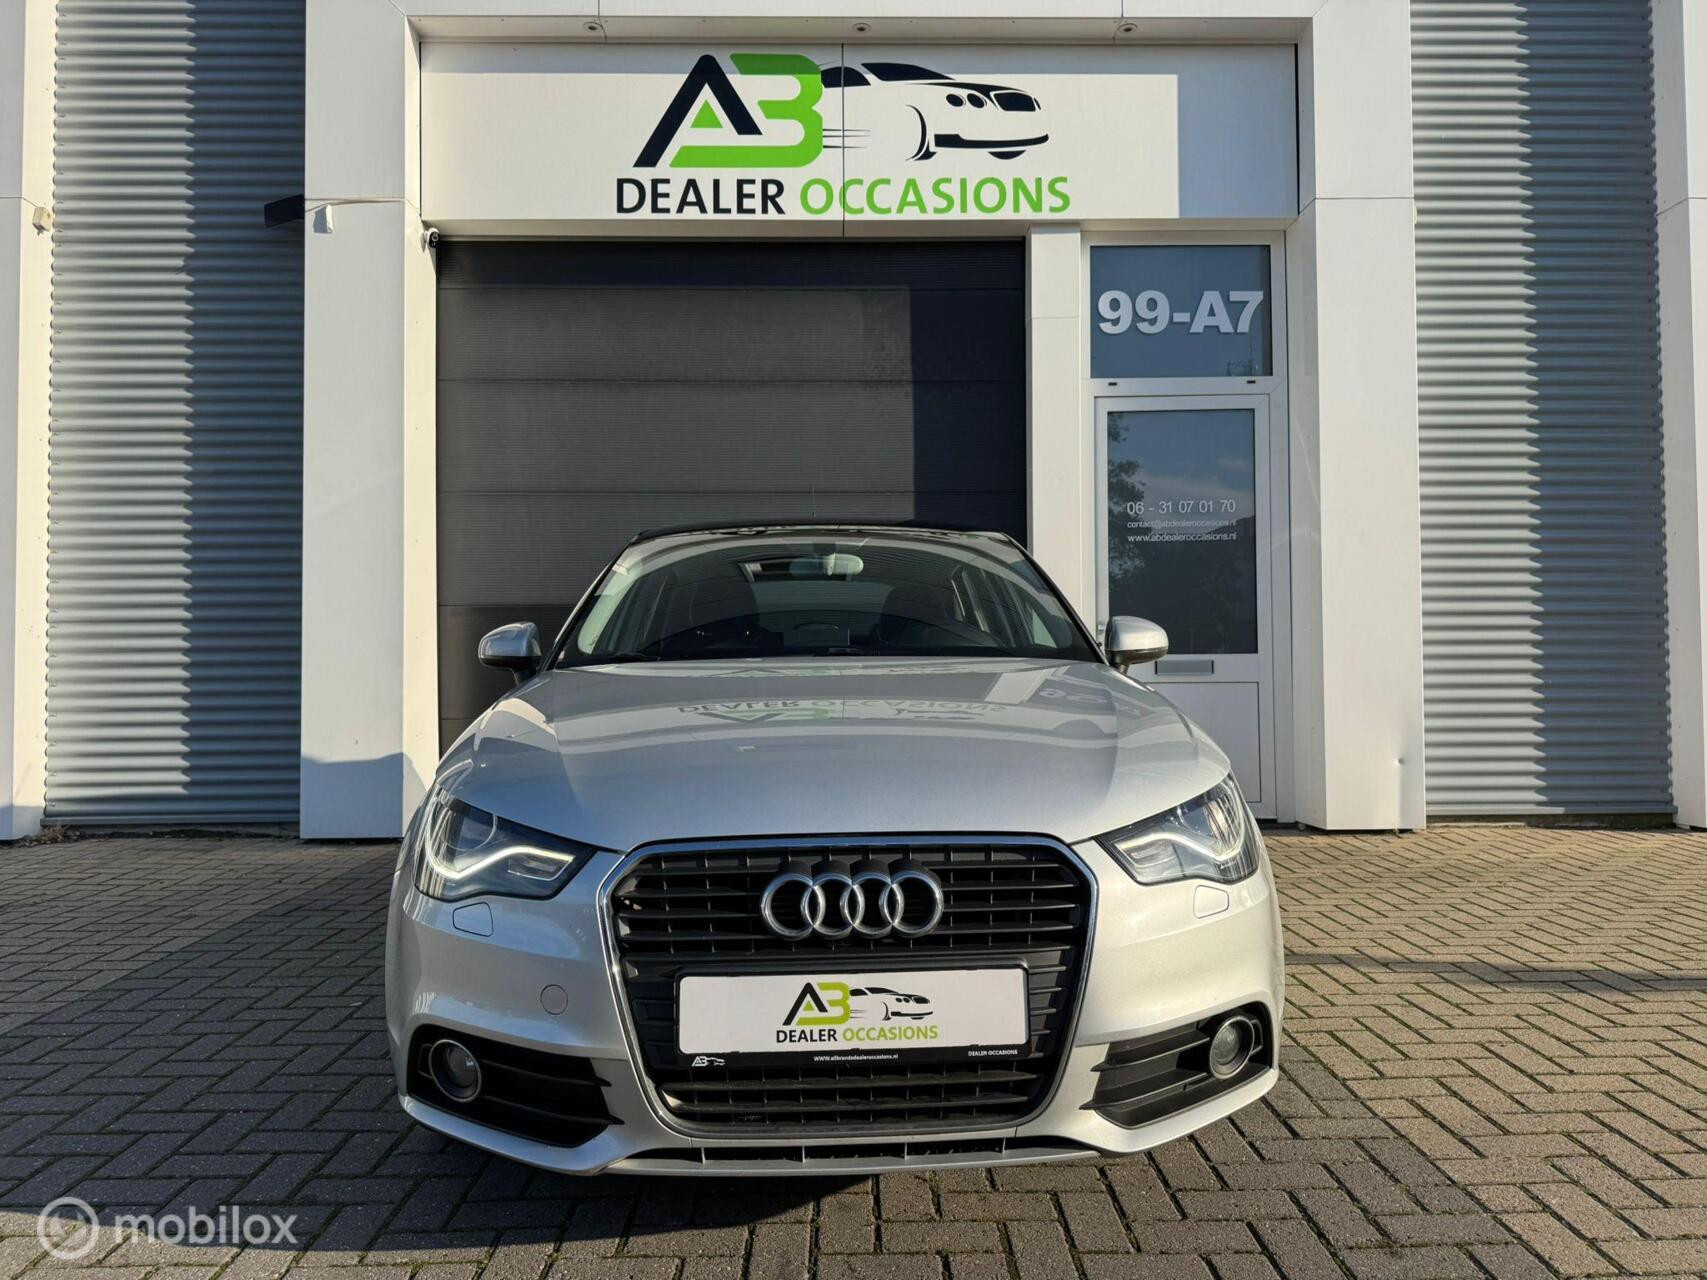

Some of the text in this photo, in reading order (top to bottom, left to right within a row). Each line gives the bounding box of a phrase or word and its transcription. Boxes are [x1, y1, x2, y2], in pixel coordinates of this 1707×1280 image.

[632, 53, 823, 168] AB
[616, 175, 1071, 216] DEALER OCCASIONS
[1097, 289, 1264, 335] 99-A7
[1126, 500, 1145, 515] 06
[1158, 500, 1173, 514] 31
[1178, 500, 1194, 514] 07
[1199, 499, 1215, 513] 01
[1220, 499, 1237, 513] 70
[1126, 532, 1238, 543] www.abdealeroccasions.nl
[776, 1025, 938, 1044] DEALER OCCASIONS
